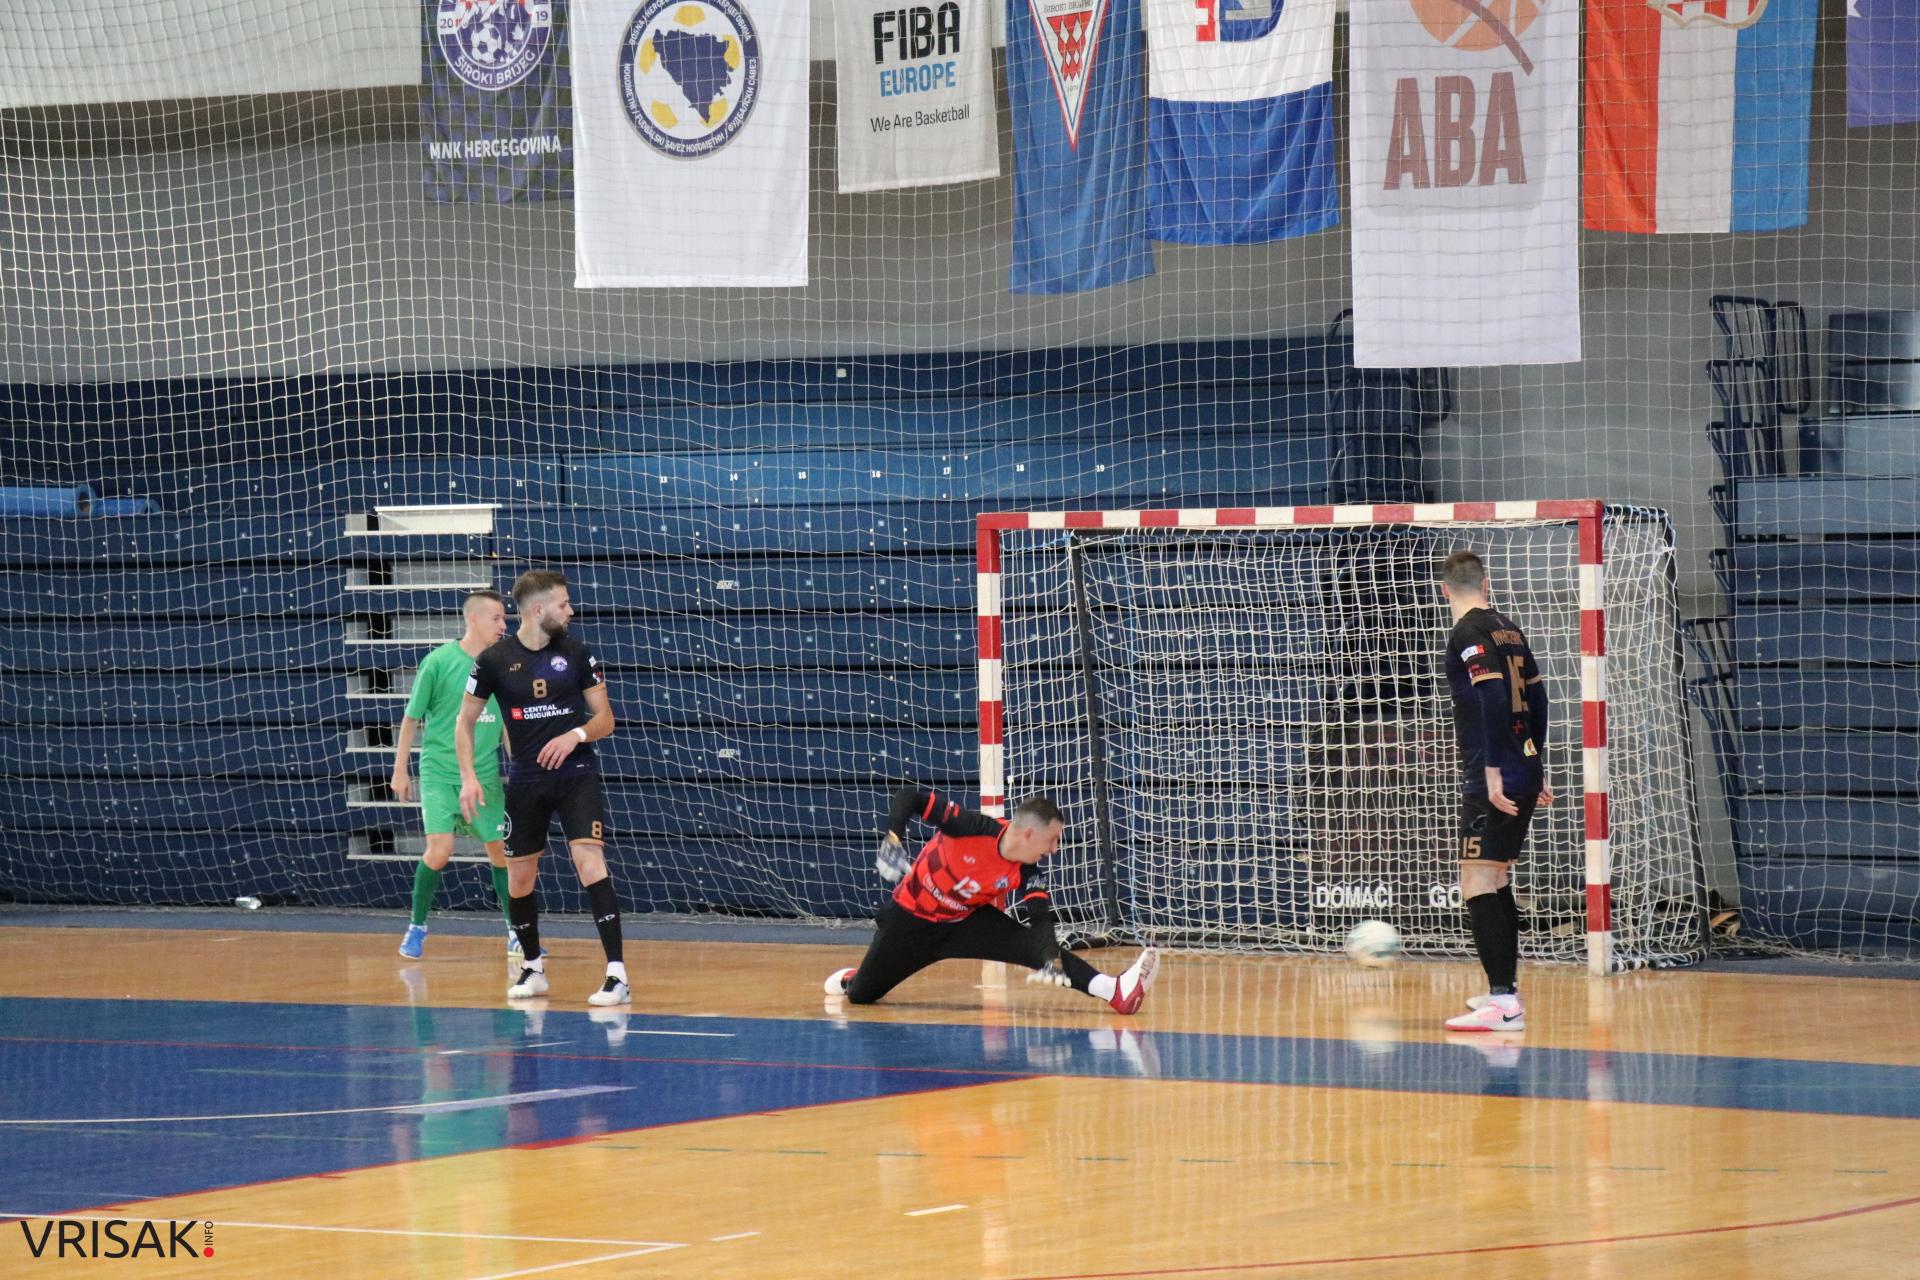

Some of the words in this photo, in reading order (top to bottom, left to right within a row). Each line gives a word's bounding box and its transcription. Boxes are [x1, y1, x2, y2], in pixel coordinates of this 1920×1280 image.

[440, 18, 454, 28] 20
[535, 10, 548, 21] 19
[628, 20, 645, 45] BOSNA
[873, 1, 960, 64] FIBA
[454, 54, 493, 85] ŠIROKI
[496, 49, 536, 84] BRIJEG
[879, 61, 956, 97] EUROPE
[623, 63, 637, 110] NOGOMETNI
[636, 114, 666, 145] FUDBALSKI
[664, 140, 685, 153] SAVEZ
[870, 116, 890, 132] We
[893, 114, 912, 128] Are
[915, 104, 969, 126] Basketball
[1383, 71, 1528, 190] ABA
[429, 141, 462, 160] MNK
[464, 135, 562, 158] HERCEGOVINA
[532, 678, 548, 699] 8
[523, 704, 557, 714] CENTRAL
[523, 707, 570, 720] OSIGURANJE
[591, 820, 603, 839] 8
[1462, 836, 1482, 858] 15
[953, 876, 981, 899] 12
[1429, 884, 1463, 909] GO
